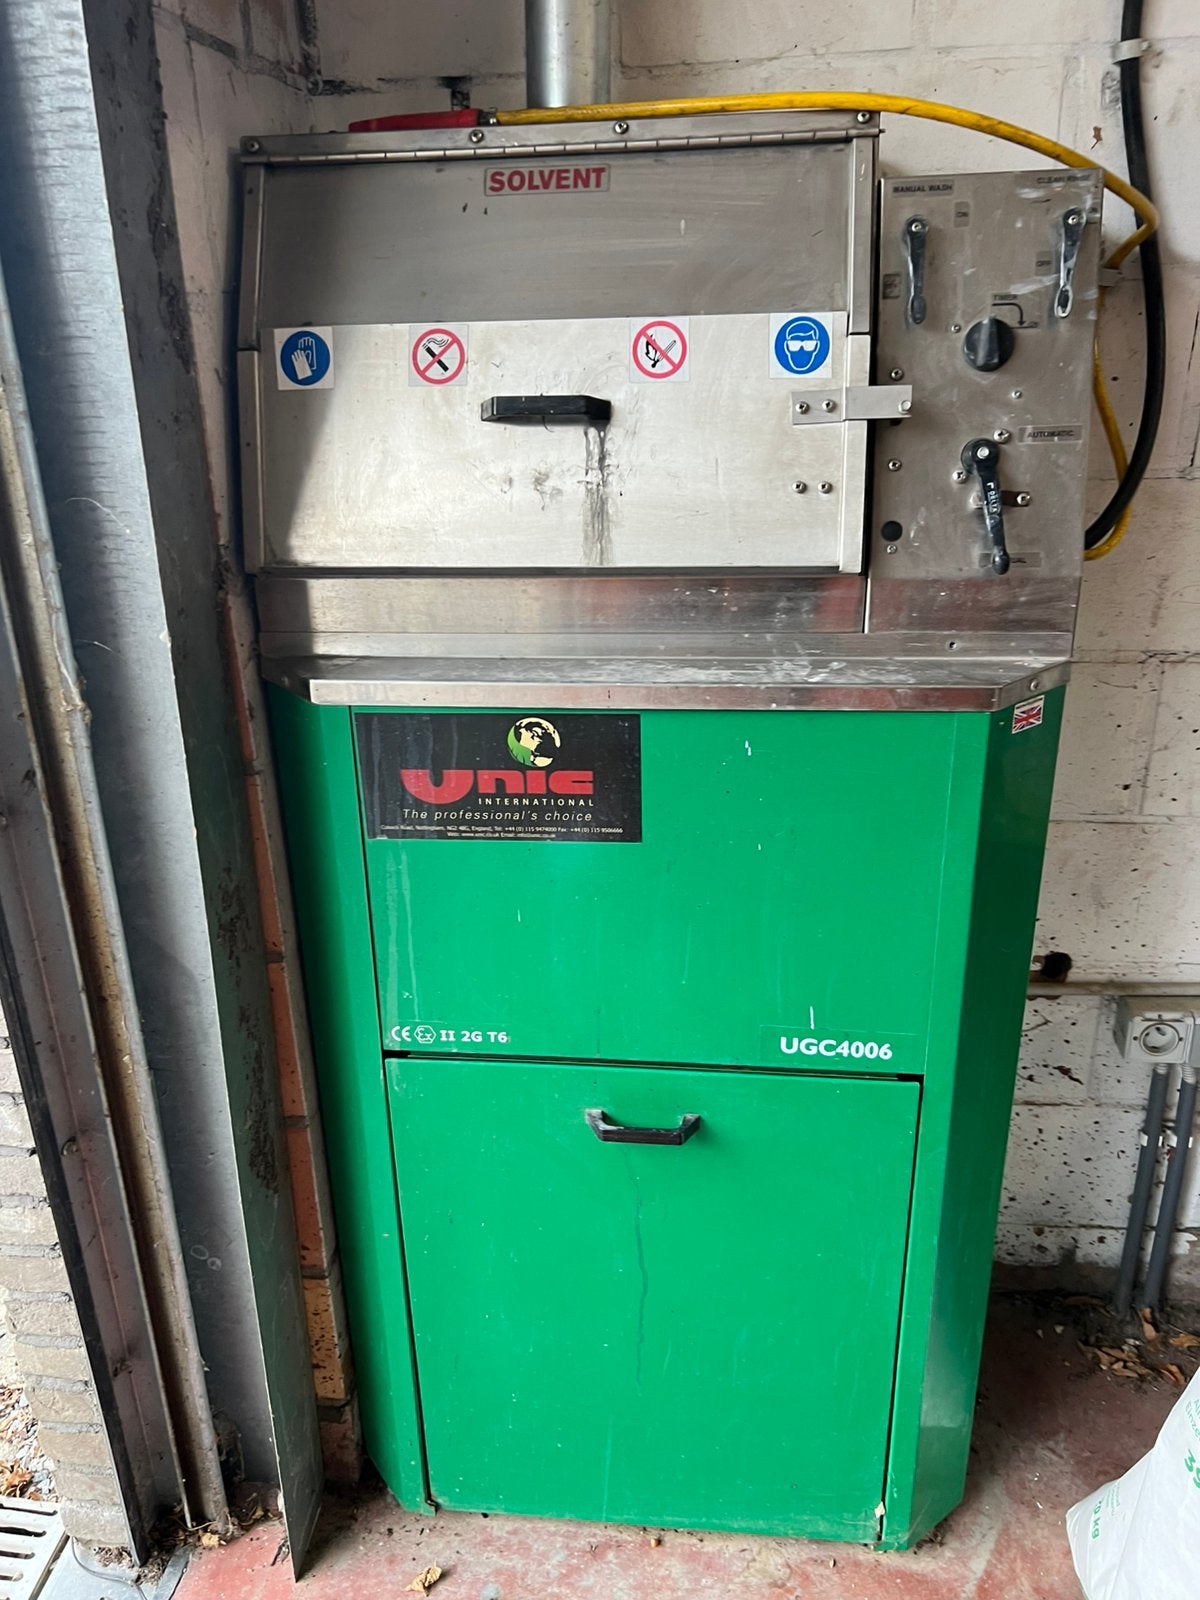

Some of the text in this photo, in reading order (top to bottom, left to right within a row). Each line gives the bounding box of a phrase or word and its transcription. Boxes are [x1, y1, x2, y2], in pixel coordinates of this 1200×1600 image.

[488, 167, 606, 192] SOLVENT
[893, 183, 953, 193] MANUAL WASH
[1027, 429, 1074, 438] AUTOMATIC
[478, 797, 594, 807] INTERNATIONAL
[402, 808, 593, 822] The professional's choice
[440, 1029, 456, 1042] II
[461, 1030, 483, 1043] 2G
[487, 1031, 508, 1044] T6
[780, 1036, 893, 1060] UGC4006
